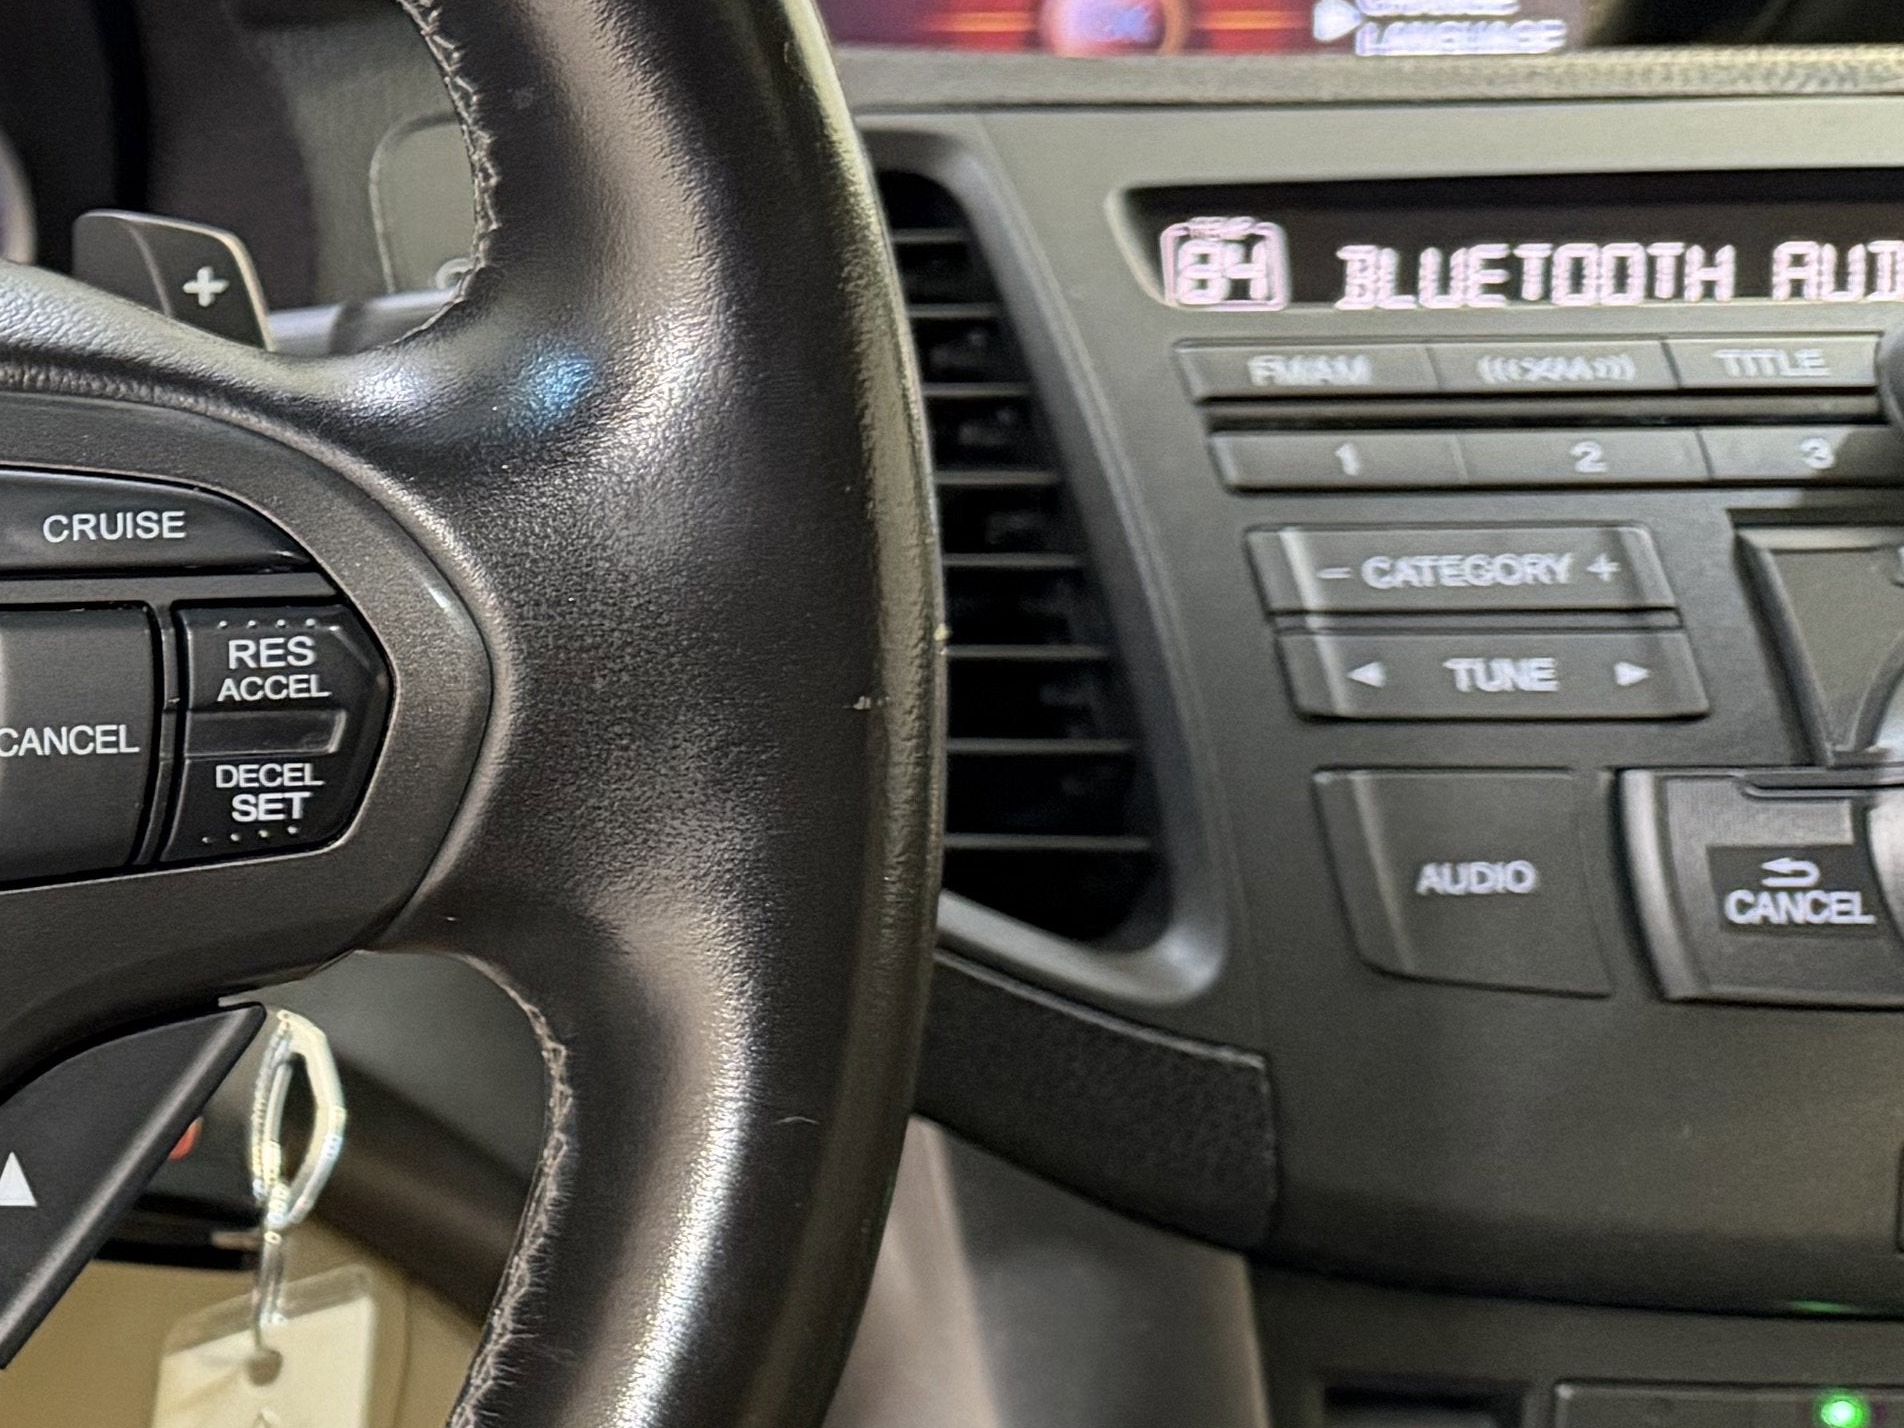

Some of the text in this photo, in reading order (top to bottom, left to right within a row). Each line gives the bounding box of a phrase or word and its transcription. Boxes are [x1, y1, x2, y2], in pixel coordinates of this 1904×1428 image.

[1335, 244, 1737, 310] BLUETOOTH
[1713, 348, 1831, 378] TITLE
[1335, 443, 1362, 478] 1
[1571, 440, 1608, 474] 2
[1800, 437, 1834, 470] 3
[42, 510, 187, 543] CRUISE
[1360, 552, 1573, 589] CATEGORY
[228, 635, 316, 670] RES
[217, 674, 332, 702] ACCEL
[1443, 657, 1560, 692] TUNE
[215, 762, 325, 789] DECEL
[231, 790, 313, 822] SET
[1416, 861, 1538, 896] AUDIO
[1724, 890, 1875, 925] CANCEL
